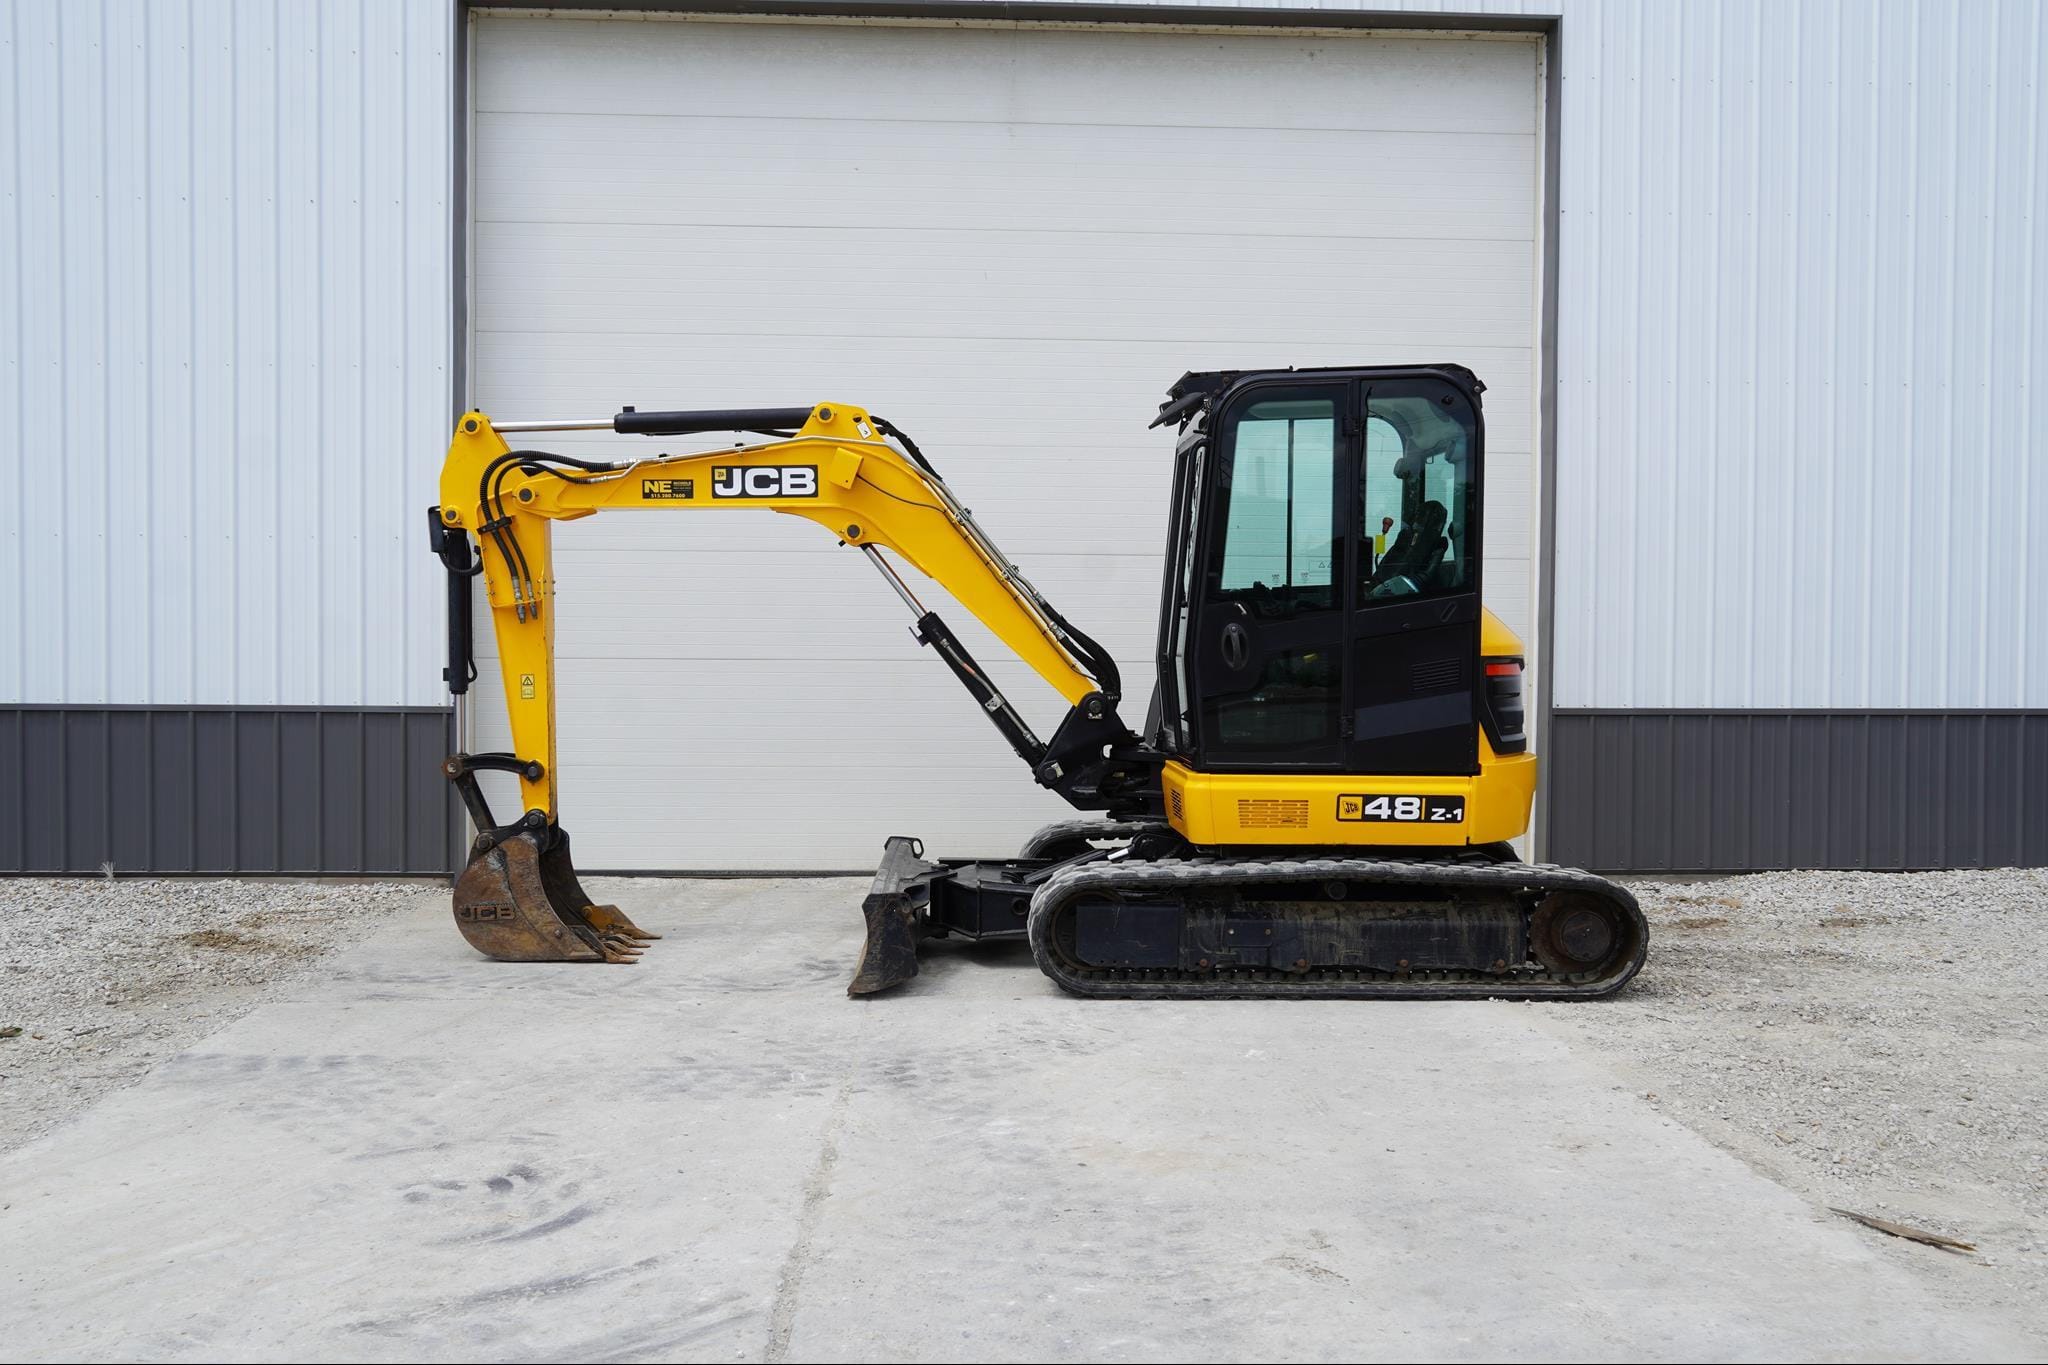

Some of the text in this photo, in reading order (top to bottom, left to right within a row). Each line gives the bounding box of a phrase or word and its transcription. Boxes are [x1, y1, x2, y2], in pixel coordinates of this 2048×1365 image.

[644, 480, 672, 493] NE
[714, 467, 816, 496] JCB
[1364, 797, 1421, 820] 48
[1430, 808, 1463, 821] Z-1
